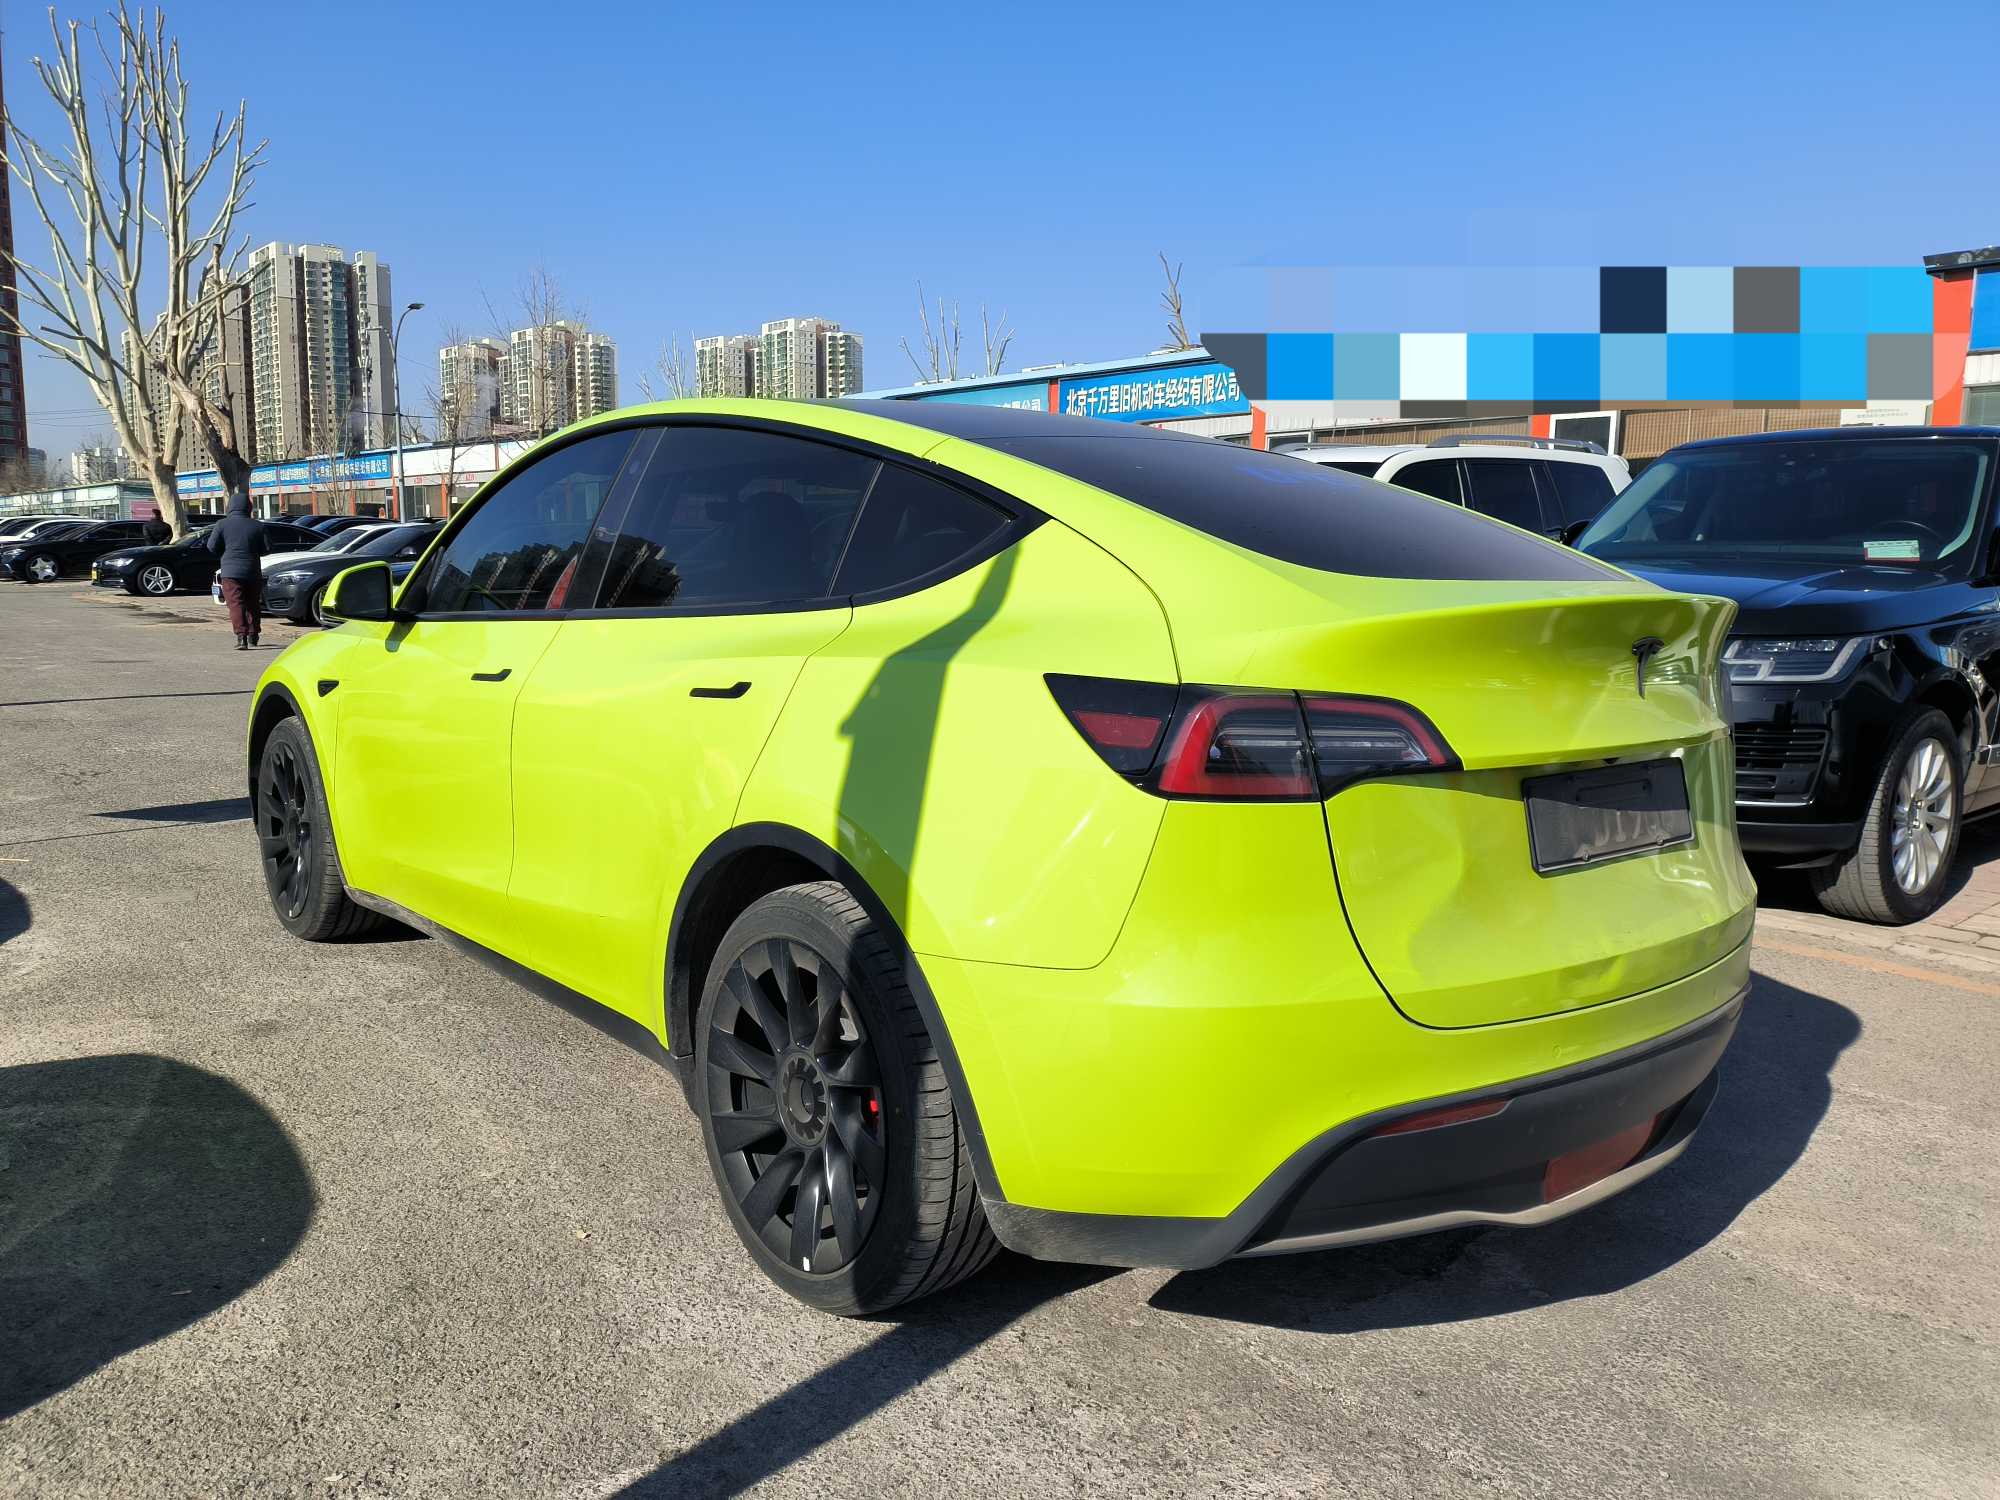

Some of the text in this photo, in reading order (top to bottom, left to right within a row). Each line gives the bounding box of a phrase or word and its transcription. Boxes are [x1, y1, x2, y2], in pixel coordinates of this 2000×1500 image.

[1066, 372, 1240, 416] 北京千万里旧机动车经纪有限公司
